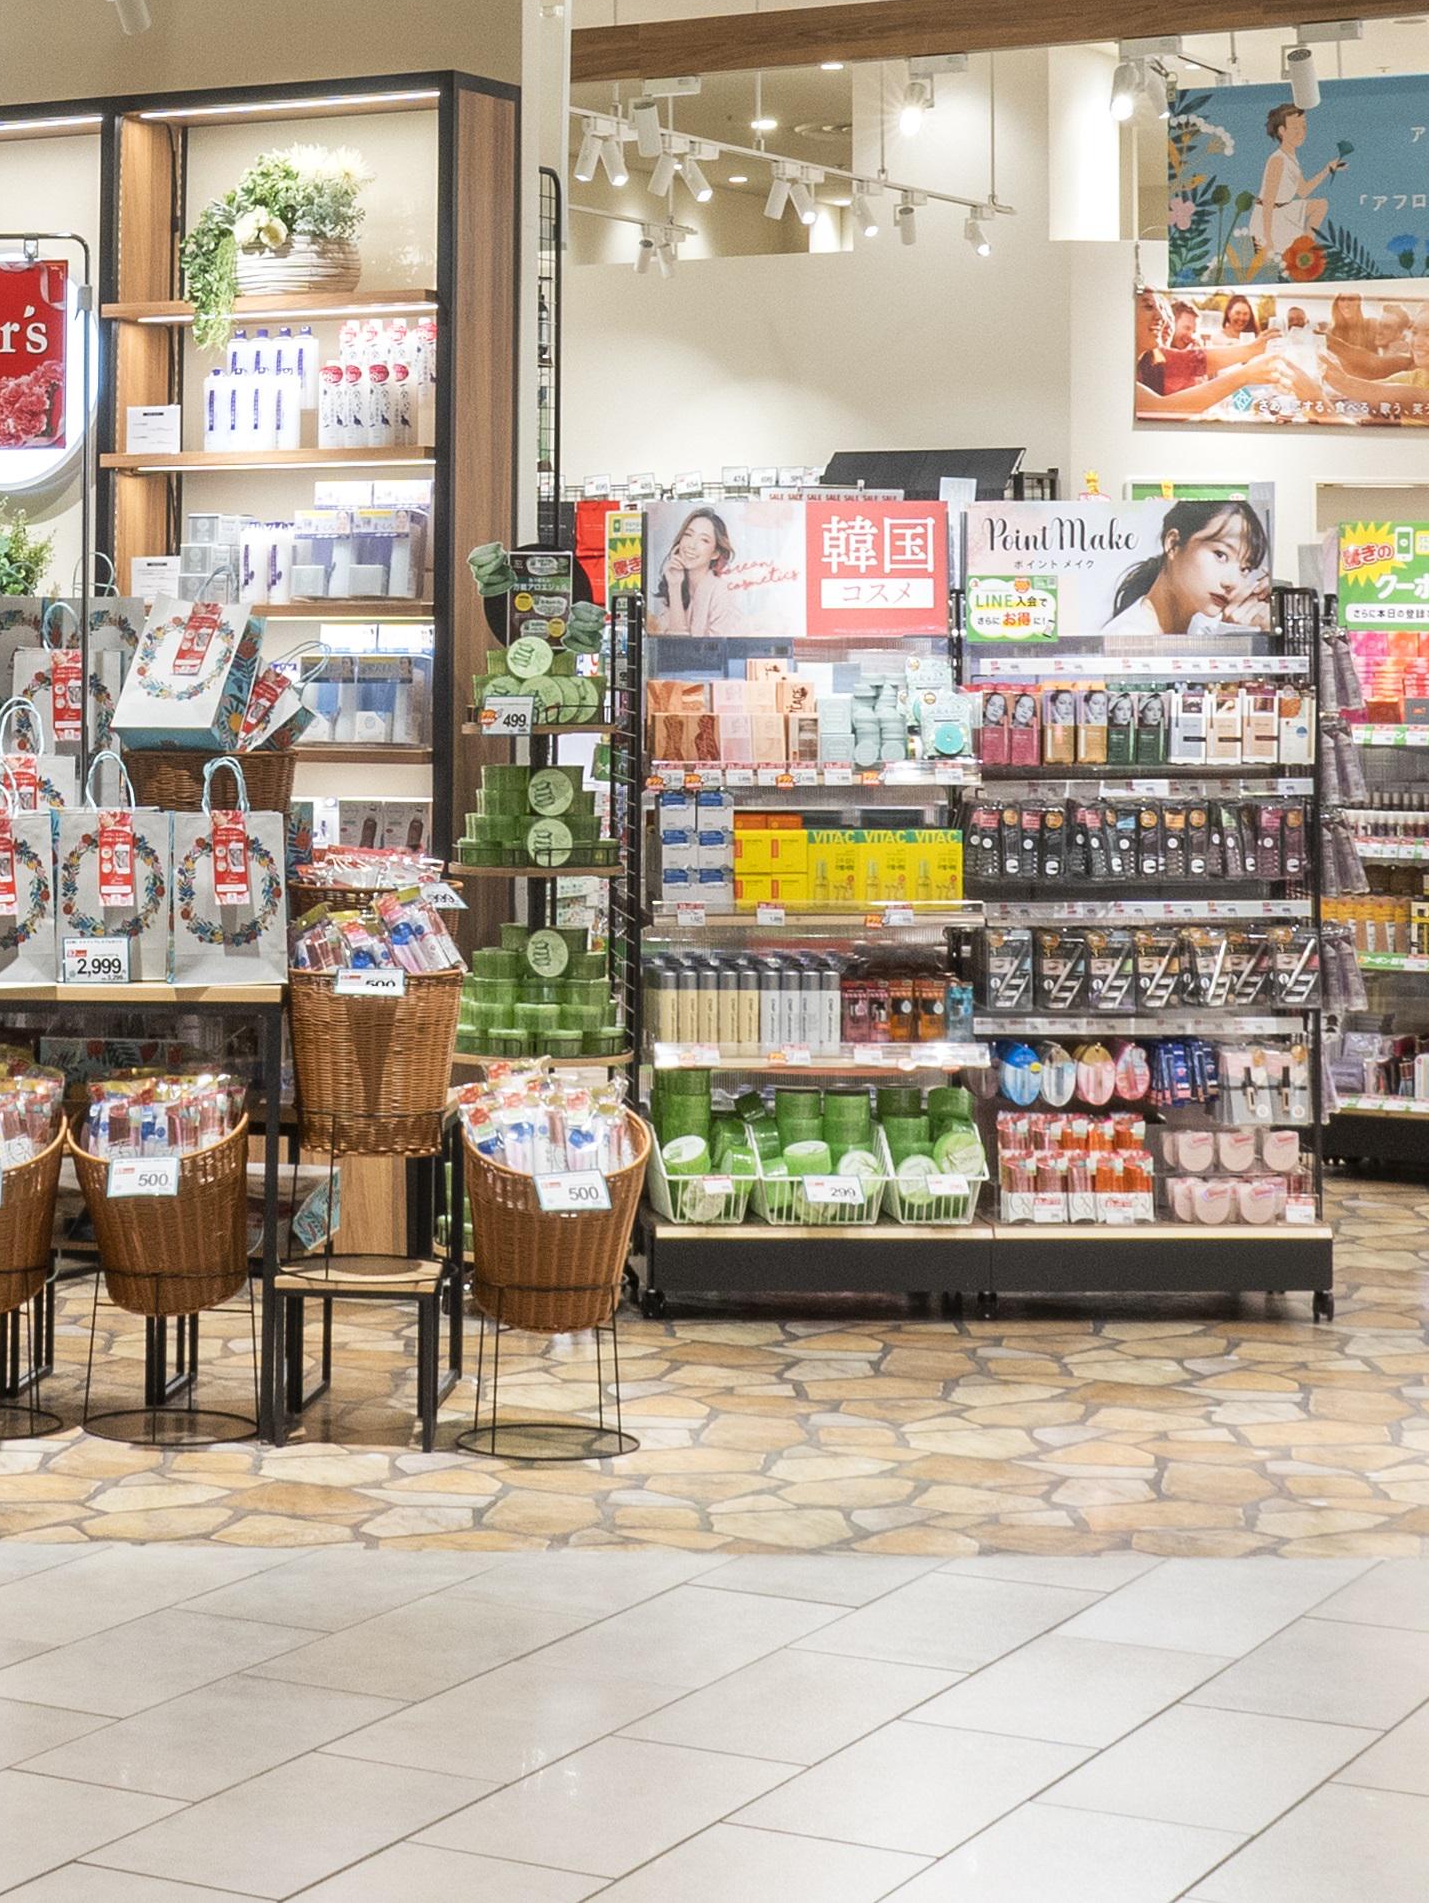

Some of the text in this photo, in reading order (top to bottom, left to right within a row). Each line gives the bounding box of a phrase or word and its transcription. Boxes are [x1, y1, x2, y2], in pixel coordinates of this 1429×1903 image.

[820, 514, 936, 575] 韓国
[1013, 558, 1096, 570] ポイント メイク
[1342, 544, 1394, 570] 驚きの
[726, 569, 800, 592] cosmetics
[841, 581, 914, 605] コスメ
[502, 712, 527, 728] 499
[76, 957, 123, 976] 2,999
[138, 1173, 170, 1187] 500
[568, 1185, 600, 1201] 500
